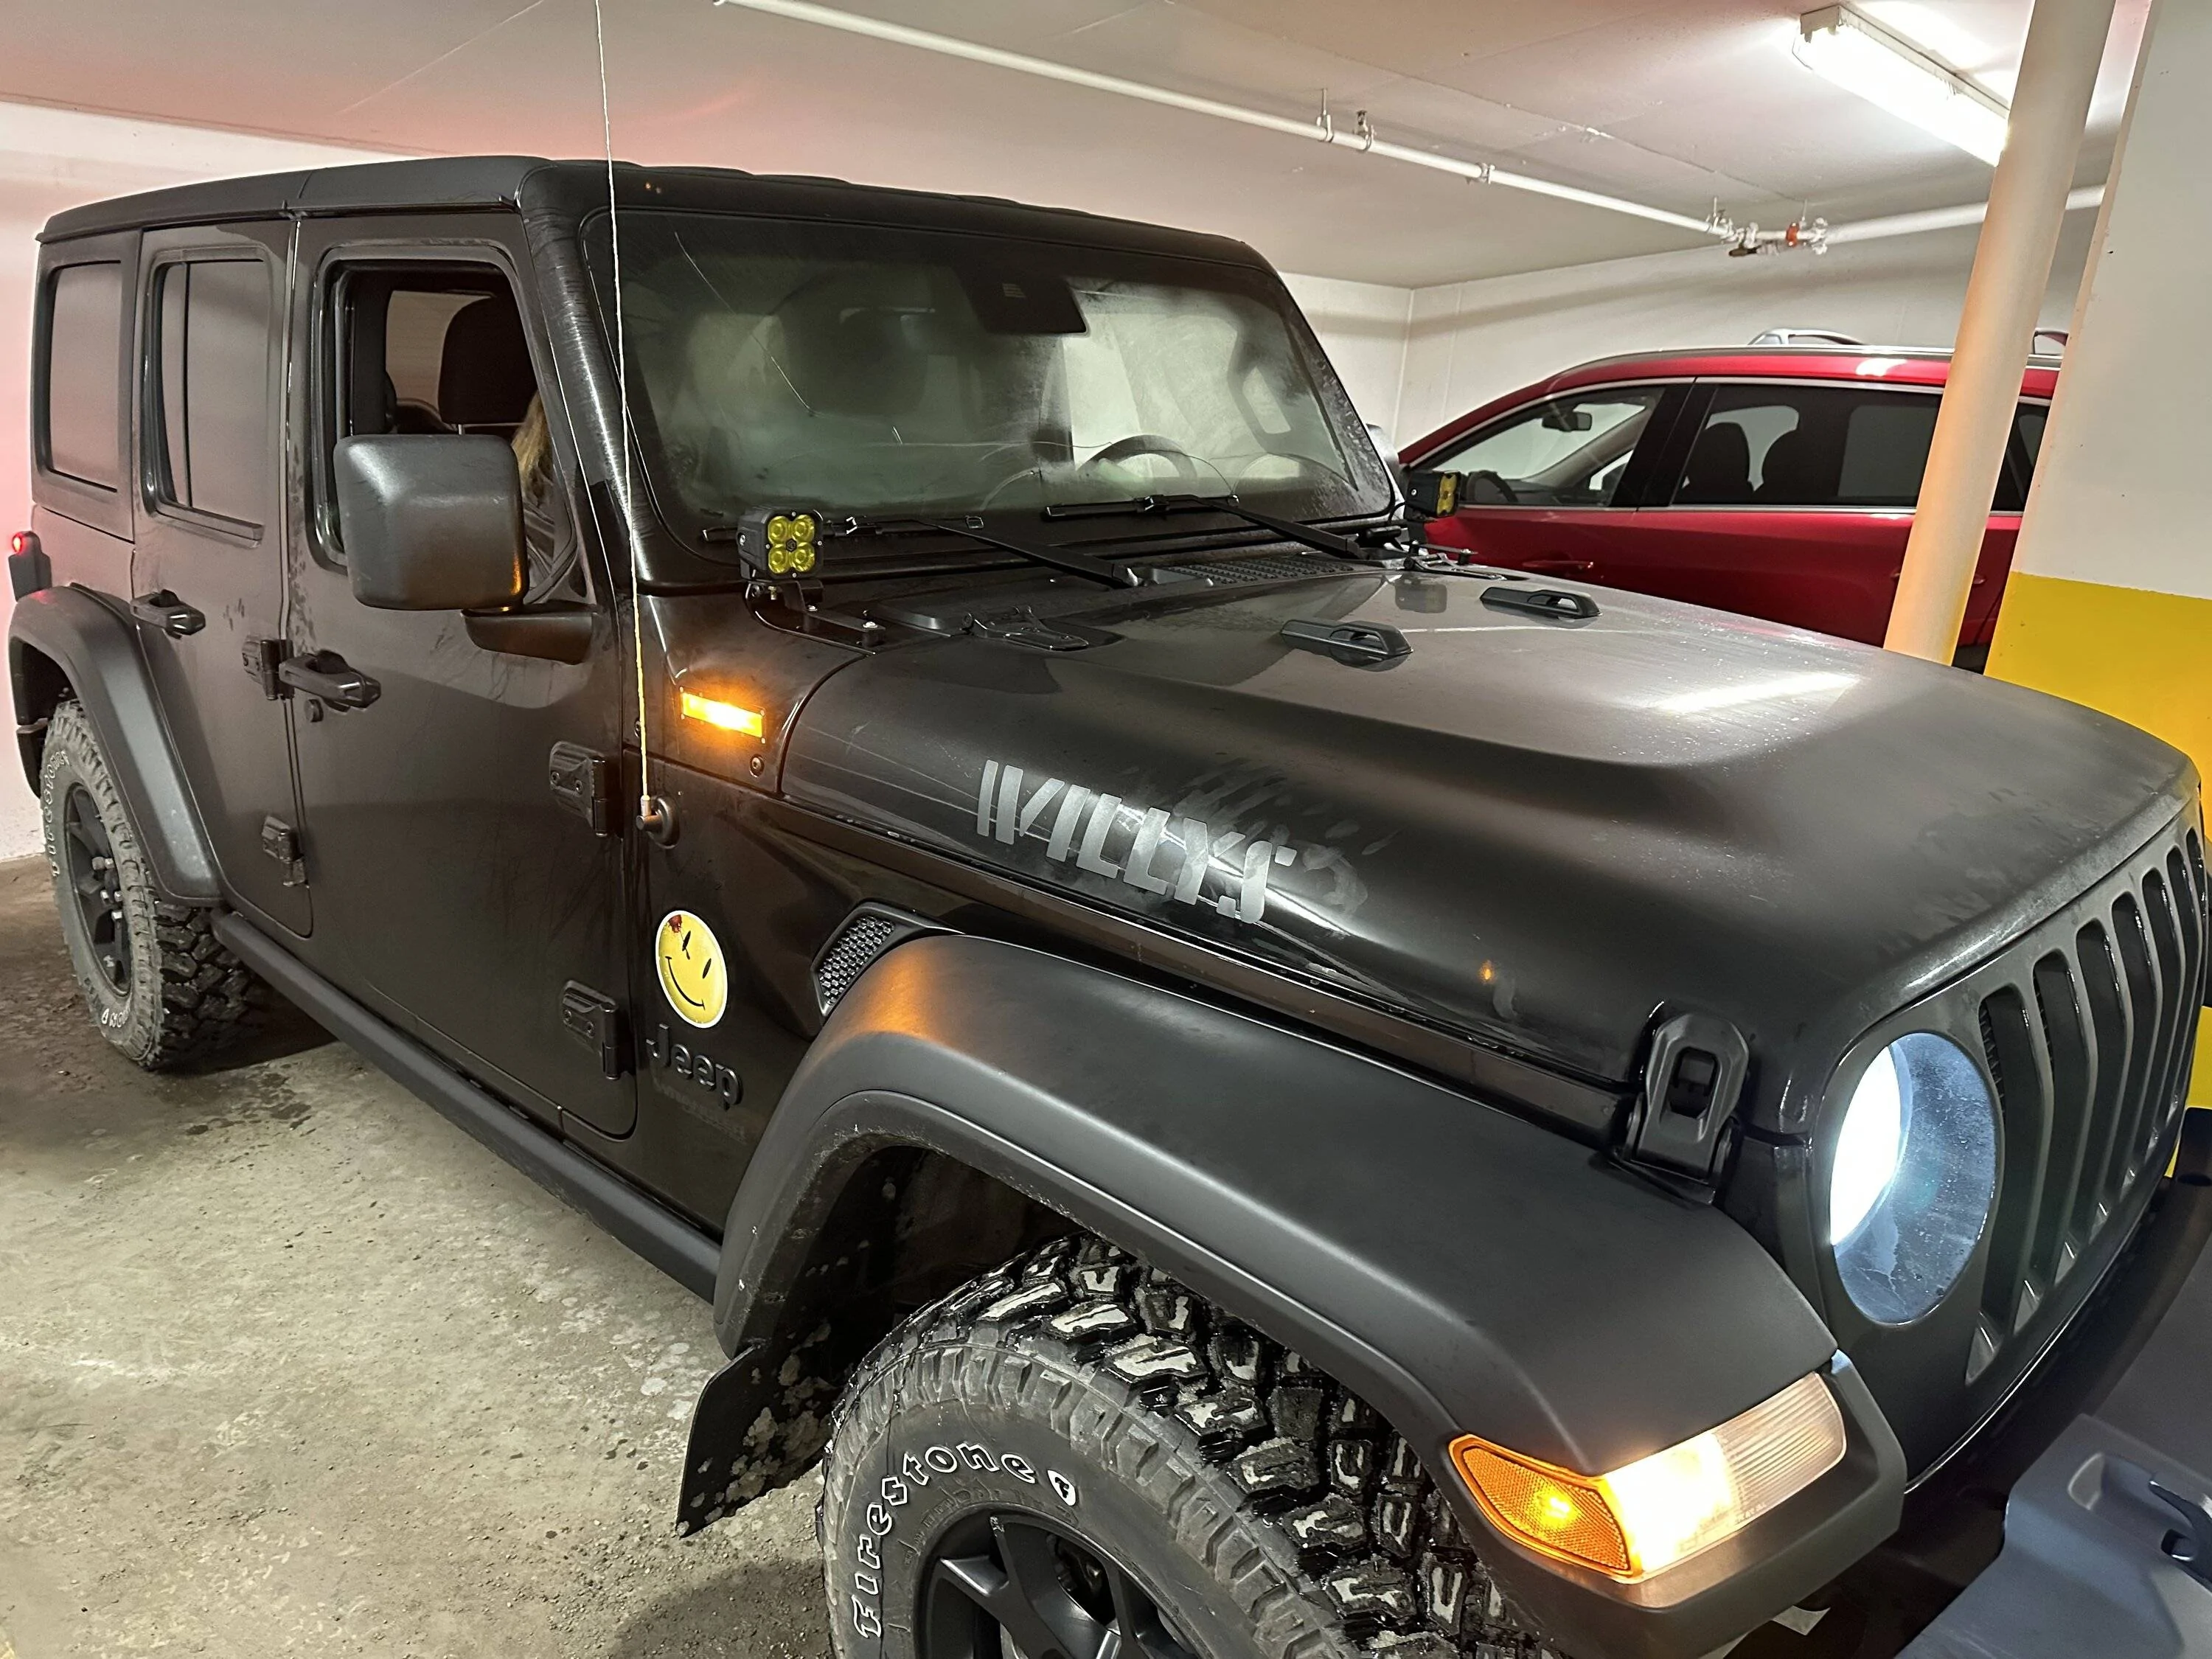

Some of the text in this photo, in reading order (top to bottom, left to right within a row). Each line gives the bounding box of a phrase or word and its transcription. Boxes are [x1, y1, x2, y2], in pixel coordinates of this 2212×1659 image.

[977, 759, 1297, 924] WILLYS
[646, 1023, 742, 1111] Jeep
[851, 1442, 1036, 1638] Firestone
